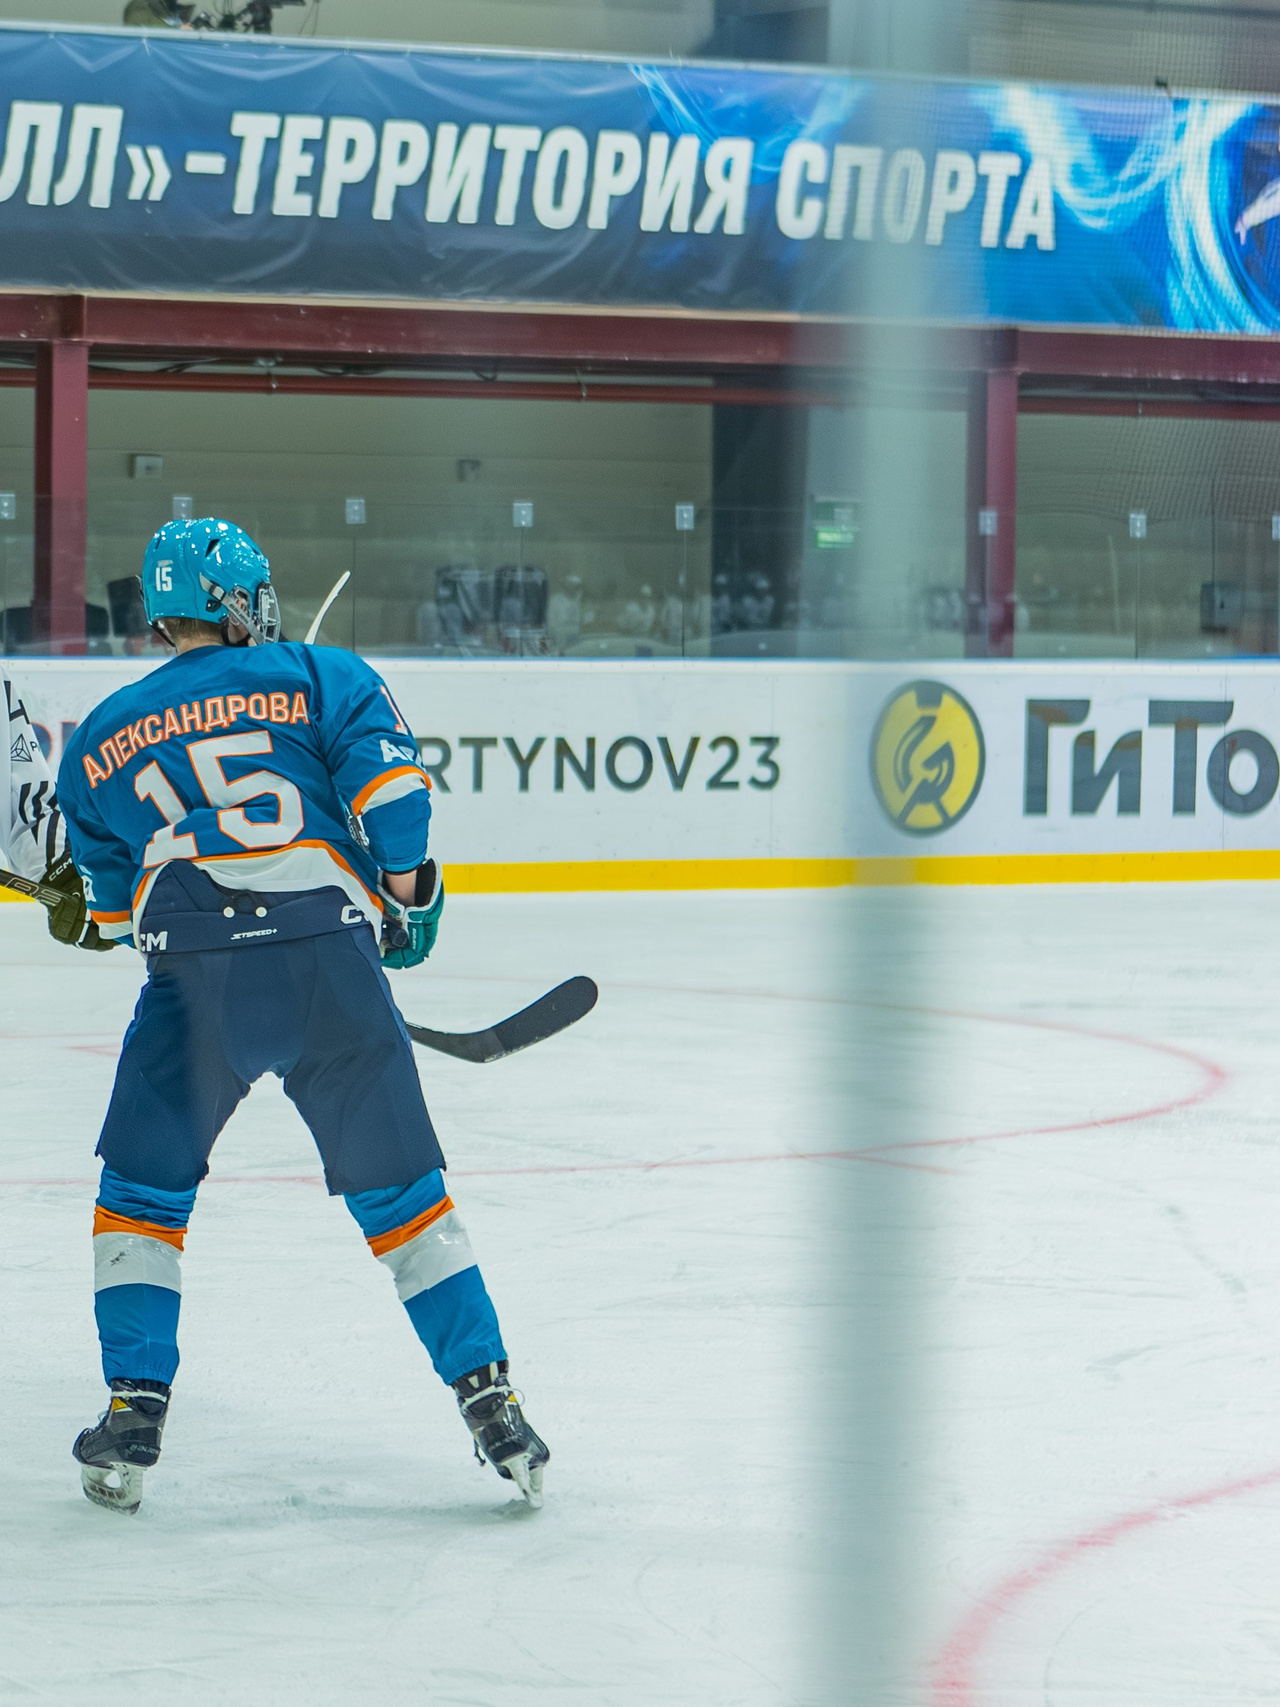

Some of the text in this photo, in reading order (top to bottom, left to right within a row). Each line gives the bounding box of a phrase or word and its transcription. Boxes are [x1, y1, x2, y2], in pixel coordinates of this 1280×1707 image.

[775, 138, 1056, 251] СПОРТА
[155, 566, 173, 592] 15
[82, 691, 310, 789] АЛЕКСАНДРОВА
[414, 735, 782, 794] RTYNOV23
[133, 730, 304, 869] 15
[48, 857, 73, 882] CCM
